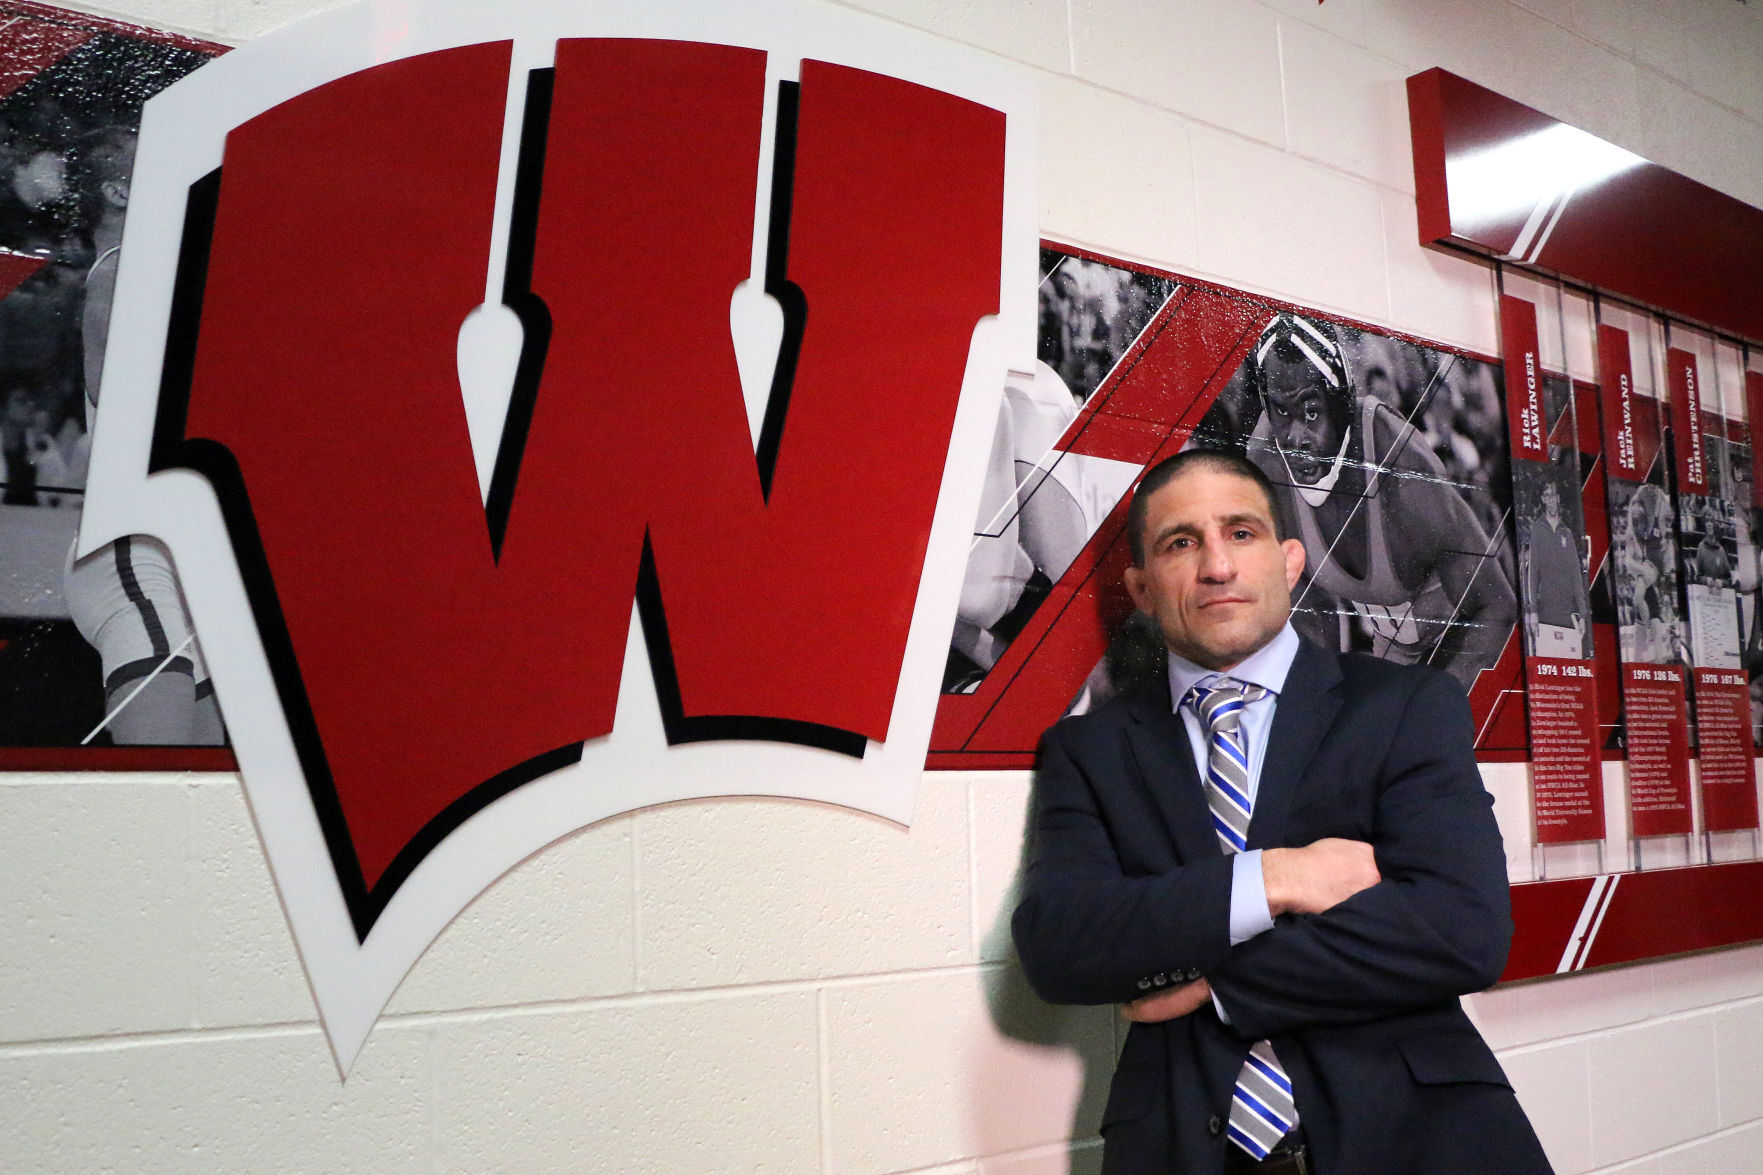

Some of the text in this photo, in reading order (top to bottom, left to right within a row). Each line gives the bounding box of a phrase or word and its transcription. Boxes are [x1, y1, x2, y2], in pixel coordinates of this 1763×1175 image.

[1525, 351, 1541, 451] LAWINGER
[1620, 374, 1635, 470] REINWAND
[1521, 407, 1531, 449] Rick
[1685, 366, 1703, 485] CHRISTENSON
[1618, 430, 1627, 468] Jack
[1687, 457, 1695, 483] Pat
[150, 38, 1006, 945] W
[1537, 664, 1594, 678] 1974 142 lbs.
[1633, 670, 1651, 680] 1976
[1653, 670, 1666, 681] 126
